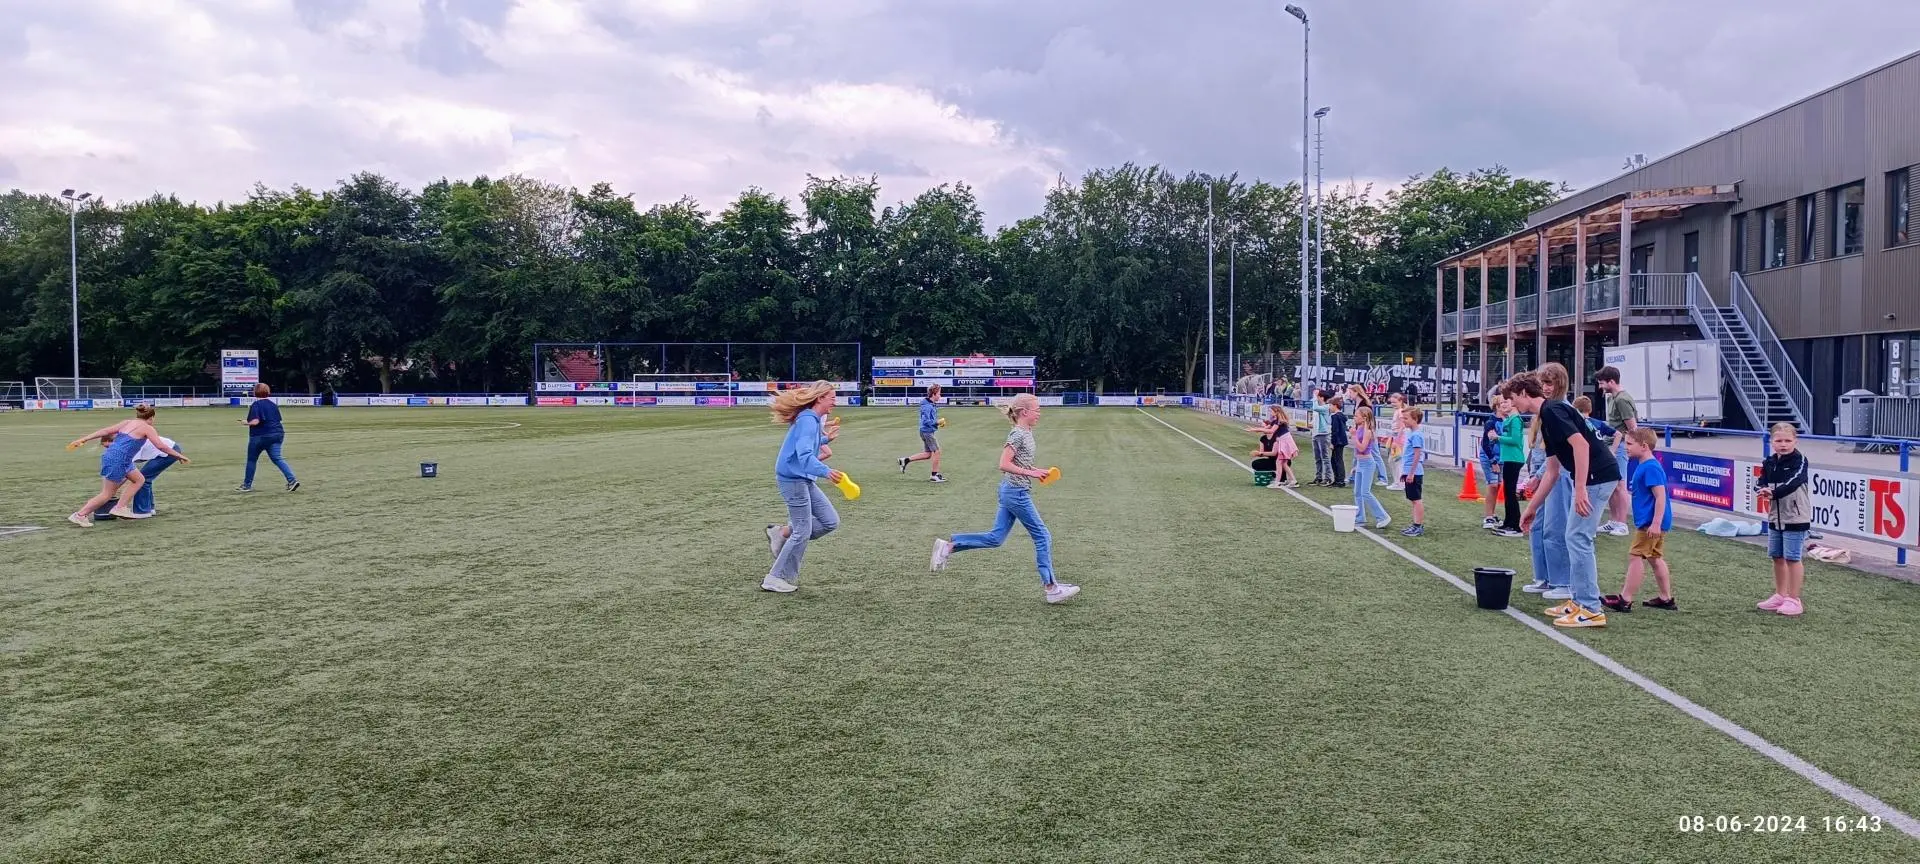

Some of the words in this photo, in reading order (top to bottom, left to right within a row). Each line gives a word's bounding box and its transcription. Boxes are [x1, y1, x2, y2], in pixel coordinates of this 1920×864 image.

[1672, 461, 1731, 478] INSTALLATIETECHNIEK
[1686, 474, 1720, 487] IJZERWAREN
[1858, 479, 1867, 532] ALBERGEN
[1869, 478, 1906, 539] TS
